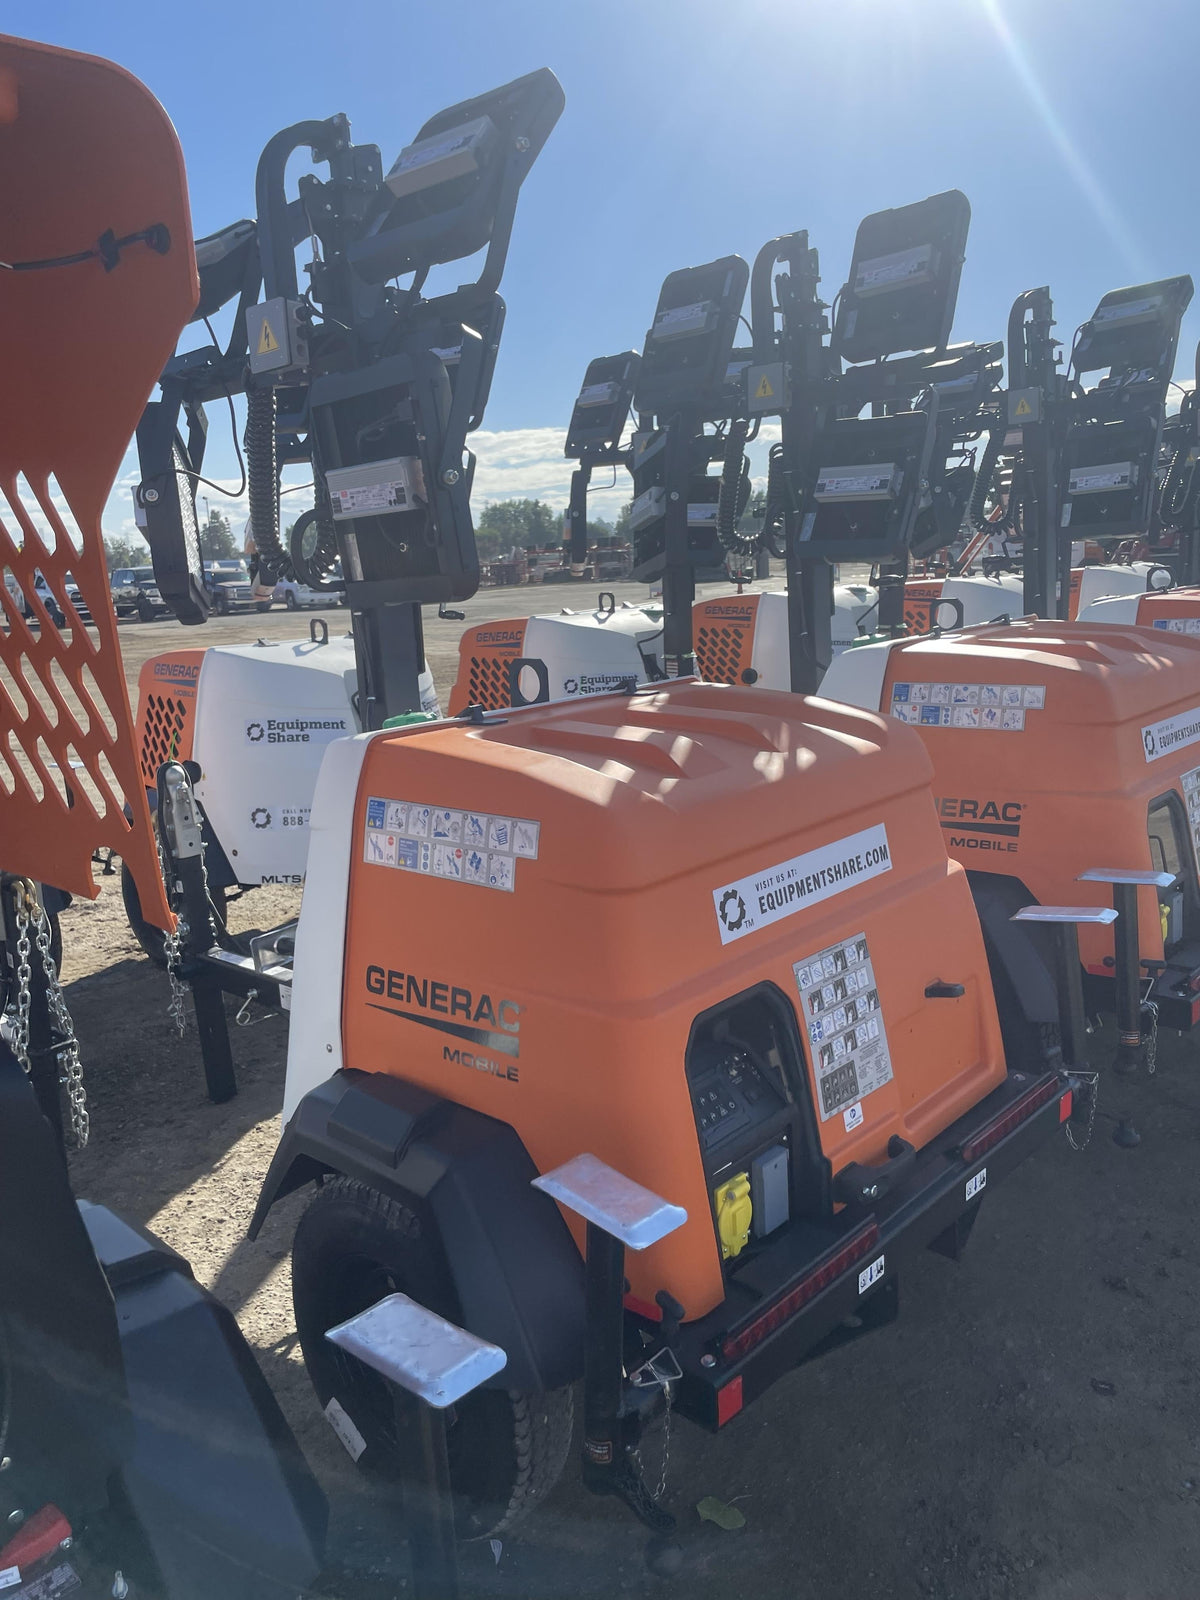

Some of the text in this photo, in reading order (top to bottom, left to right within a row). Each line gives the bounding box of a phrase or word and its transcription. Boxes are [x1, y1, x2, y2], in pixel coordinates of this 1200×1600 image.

[705, 606, 753, 616] GENERAC
[476, 630, 522, 643] GENERAC
[154, 664, 199, 677] GENERAC
[267, 719, 346, 733] Equipment
[267, 732, 310, 743] Share
[950, 837, 1018, 852] MOBILE
[754, 868, 798, 892] VISIT US AT:
[758, 844, 889, 915] EQUIPMENTSHARE.COM
[366, 964, 520, 1033] GENERAC
[443, 1046, 519, 1083] MOBILE
